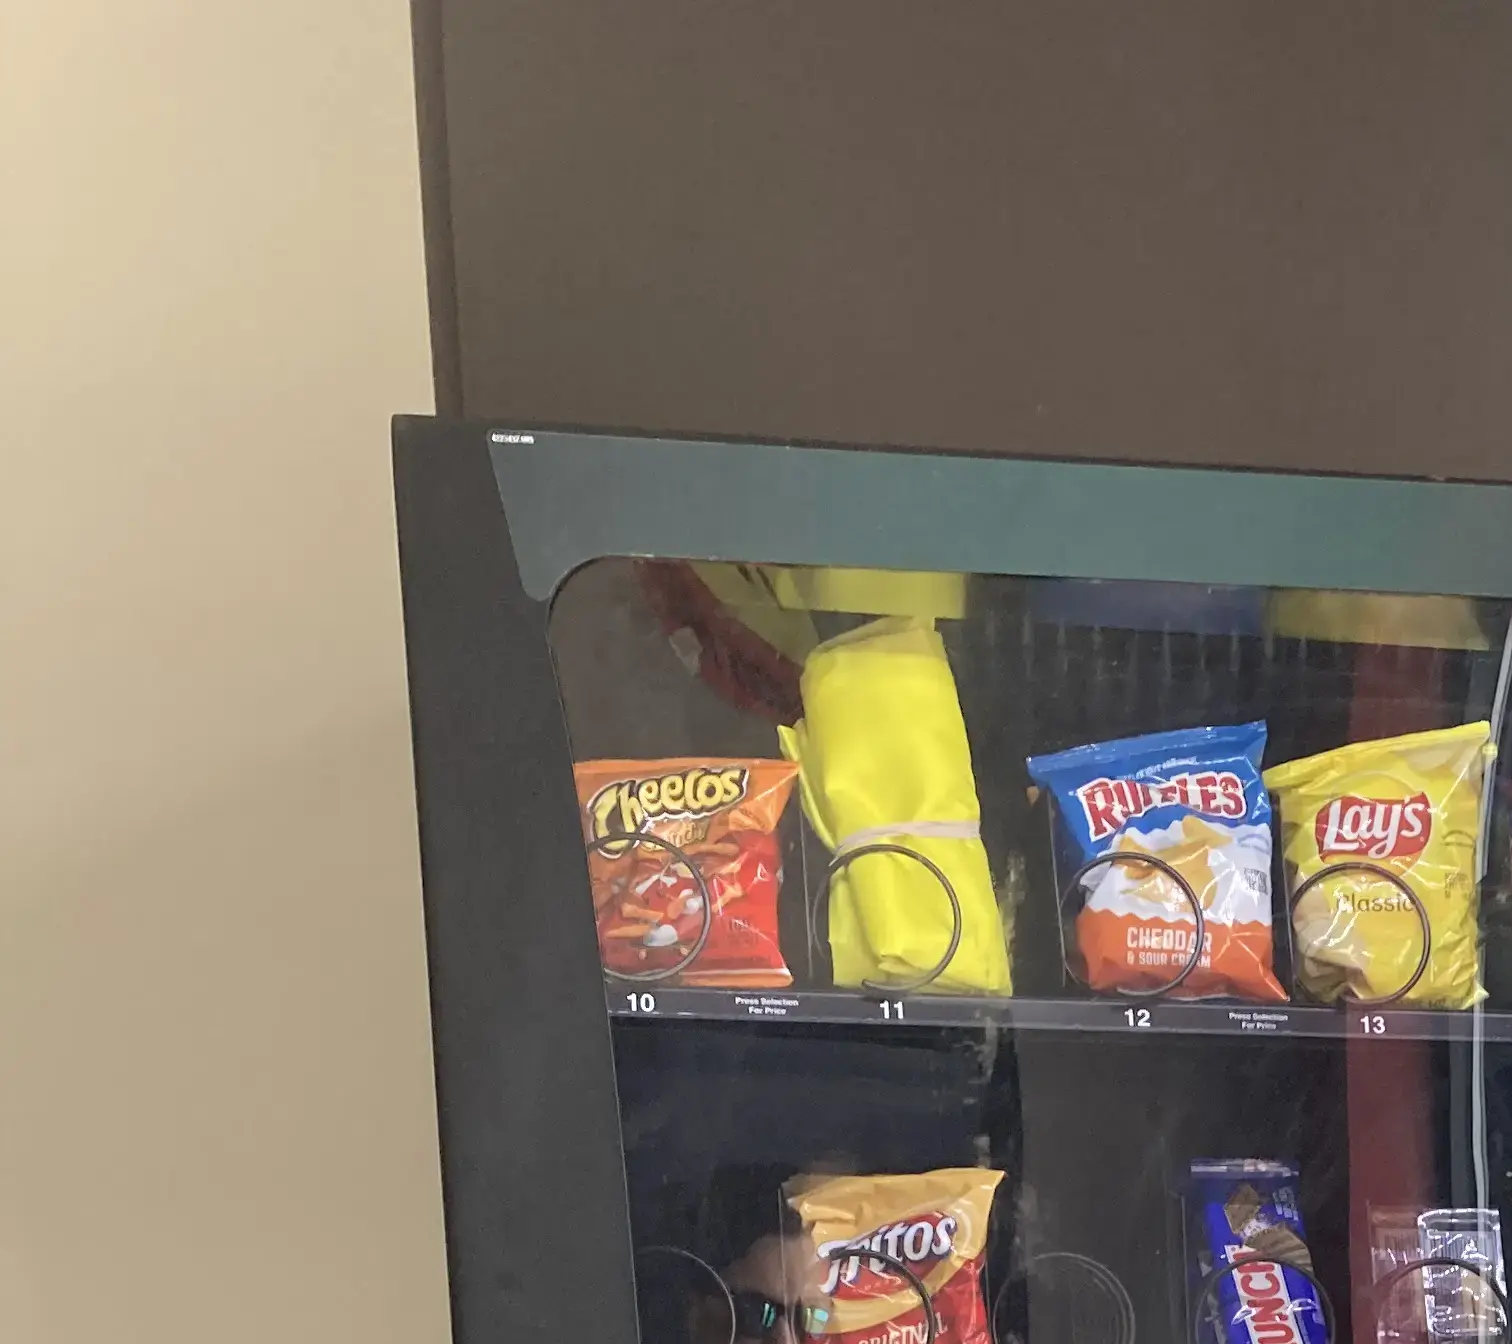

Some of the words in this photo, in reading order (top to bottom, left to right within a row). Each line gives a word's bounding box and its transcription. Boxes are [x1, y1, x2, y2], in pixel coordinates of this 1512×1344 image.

[590, 767, 745, 851] Cheetos
[1323, 796, 1425, 859] Lay's
[627, 993, 656, 1013] 10
[880, 1001, 904, 1021] 11
[1124, 1008, 1151, 1028] 12
[1360, 1016, 1386, 1034] 13
